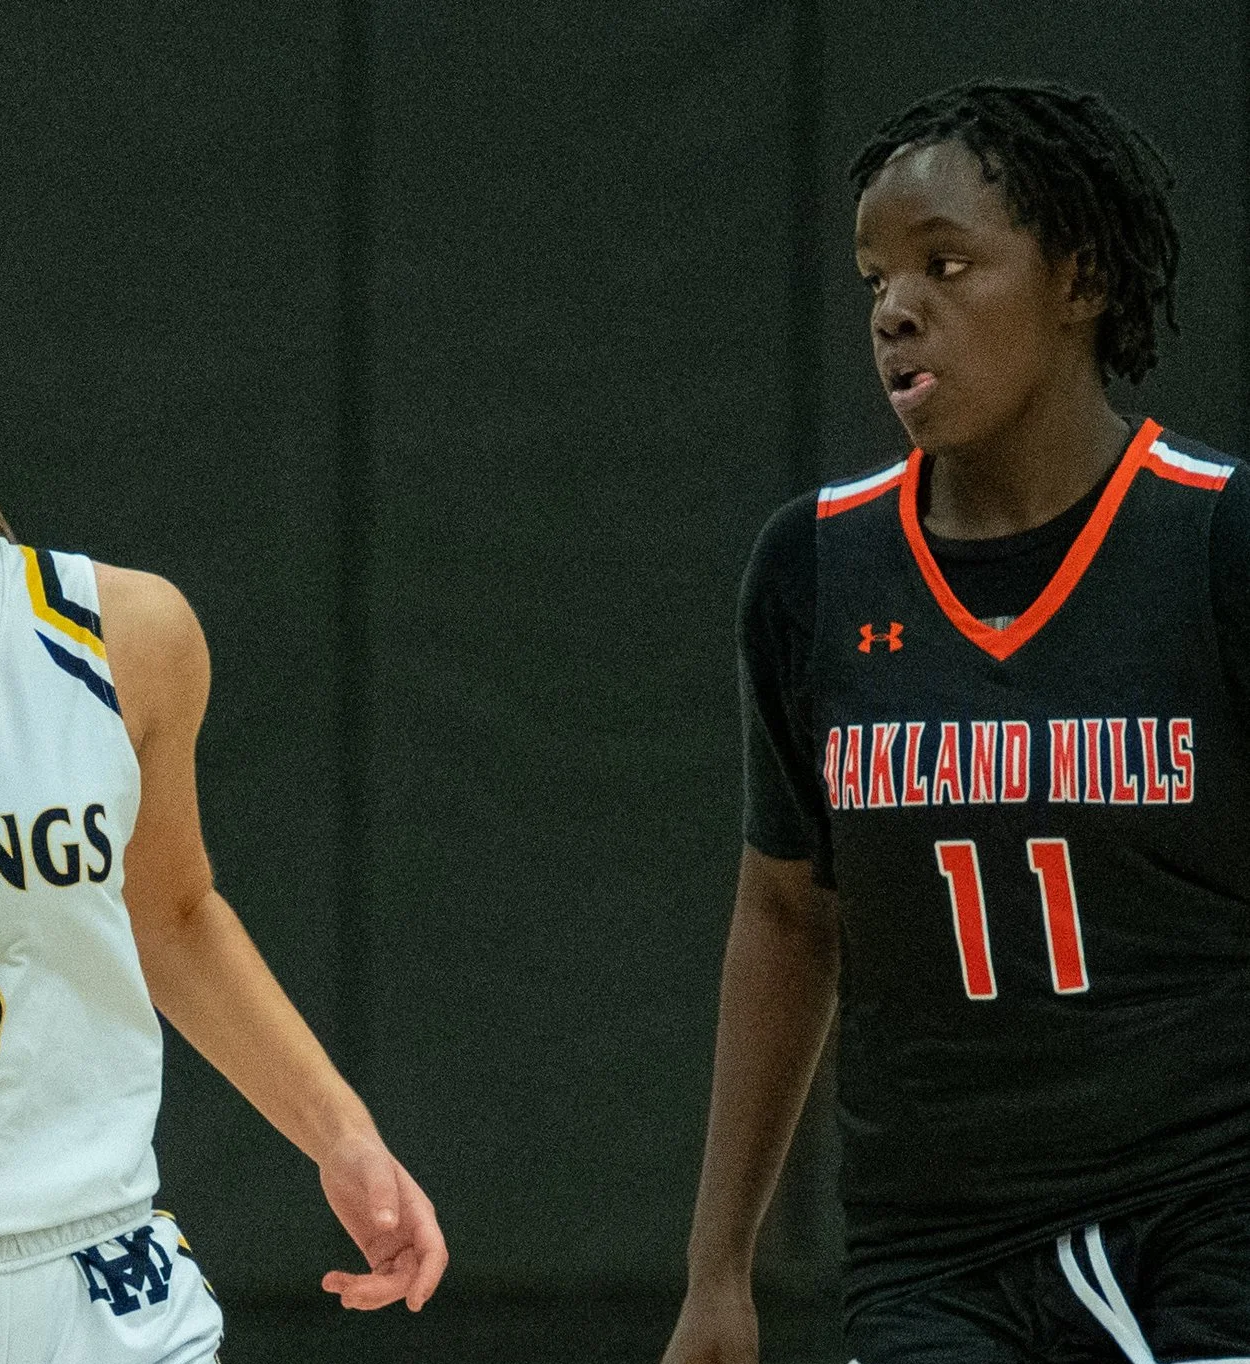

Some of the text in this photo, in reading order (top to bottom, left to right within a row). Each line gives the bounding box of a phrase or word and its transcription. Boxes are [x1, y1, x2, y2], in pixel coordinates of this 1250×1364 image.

[824, 717, 1195, 810] OAKLAND MILLS
[934, 837, 1090, 1001] 11
